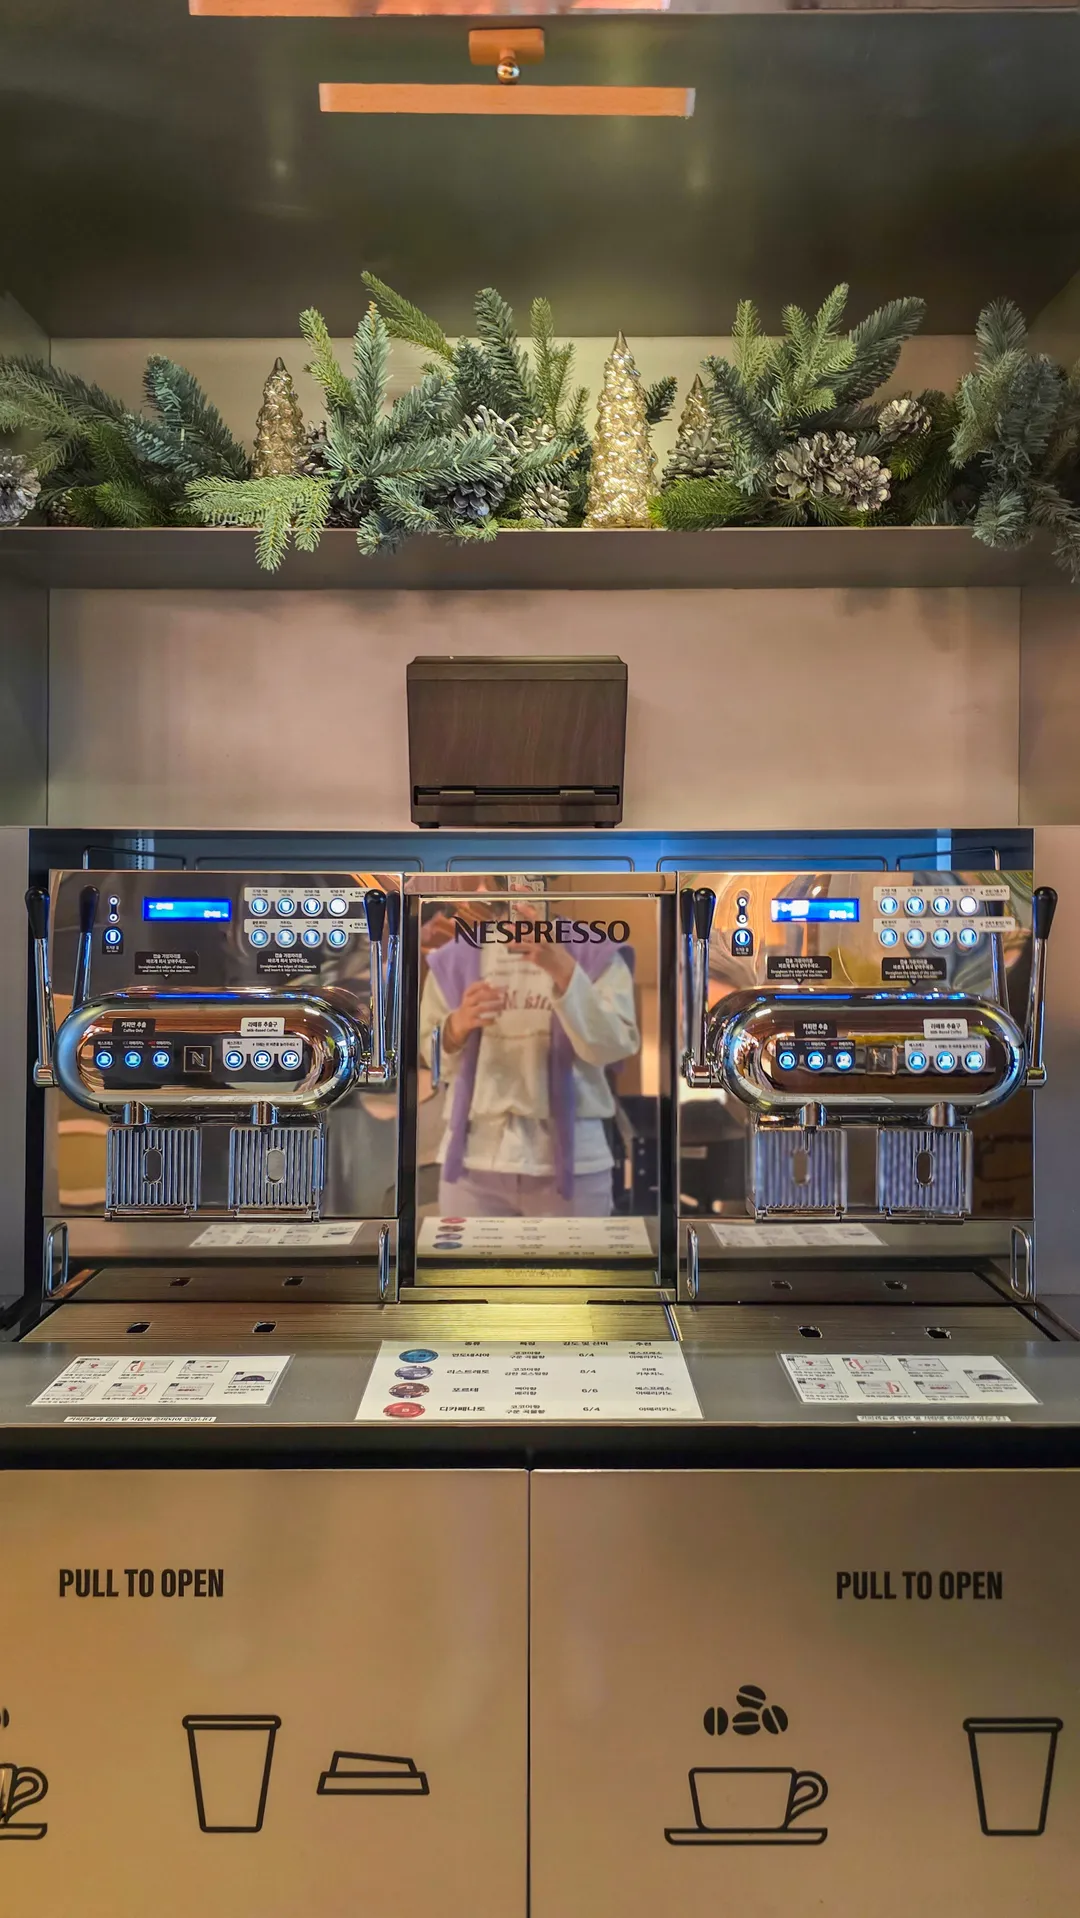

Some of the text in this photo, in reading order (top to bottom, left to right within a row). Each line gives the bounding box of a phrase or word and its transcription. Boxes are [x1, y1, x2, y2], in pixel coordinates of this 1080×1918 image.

[452, 915, 630, 949] NESPRESSO
[59, 1569, 224, 1597] PULL TO OPEN
[836, 1571, 1003, 1600] PULL TO OPEN
